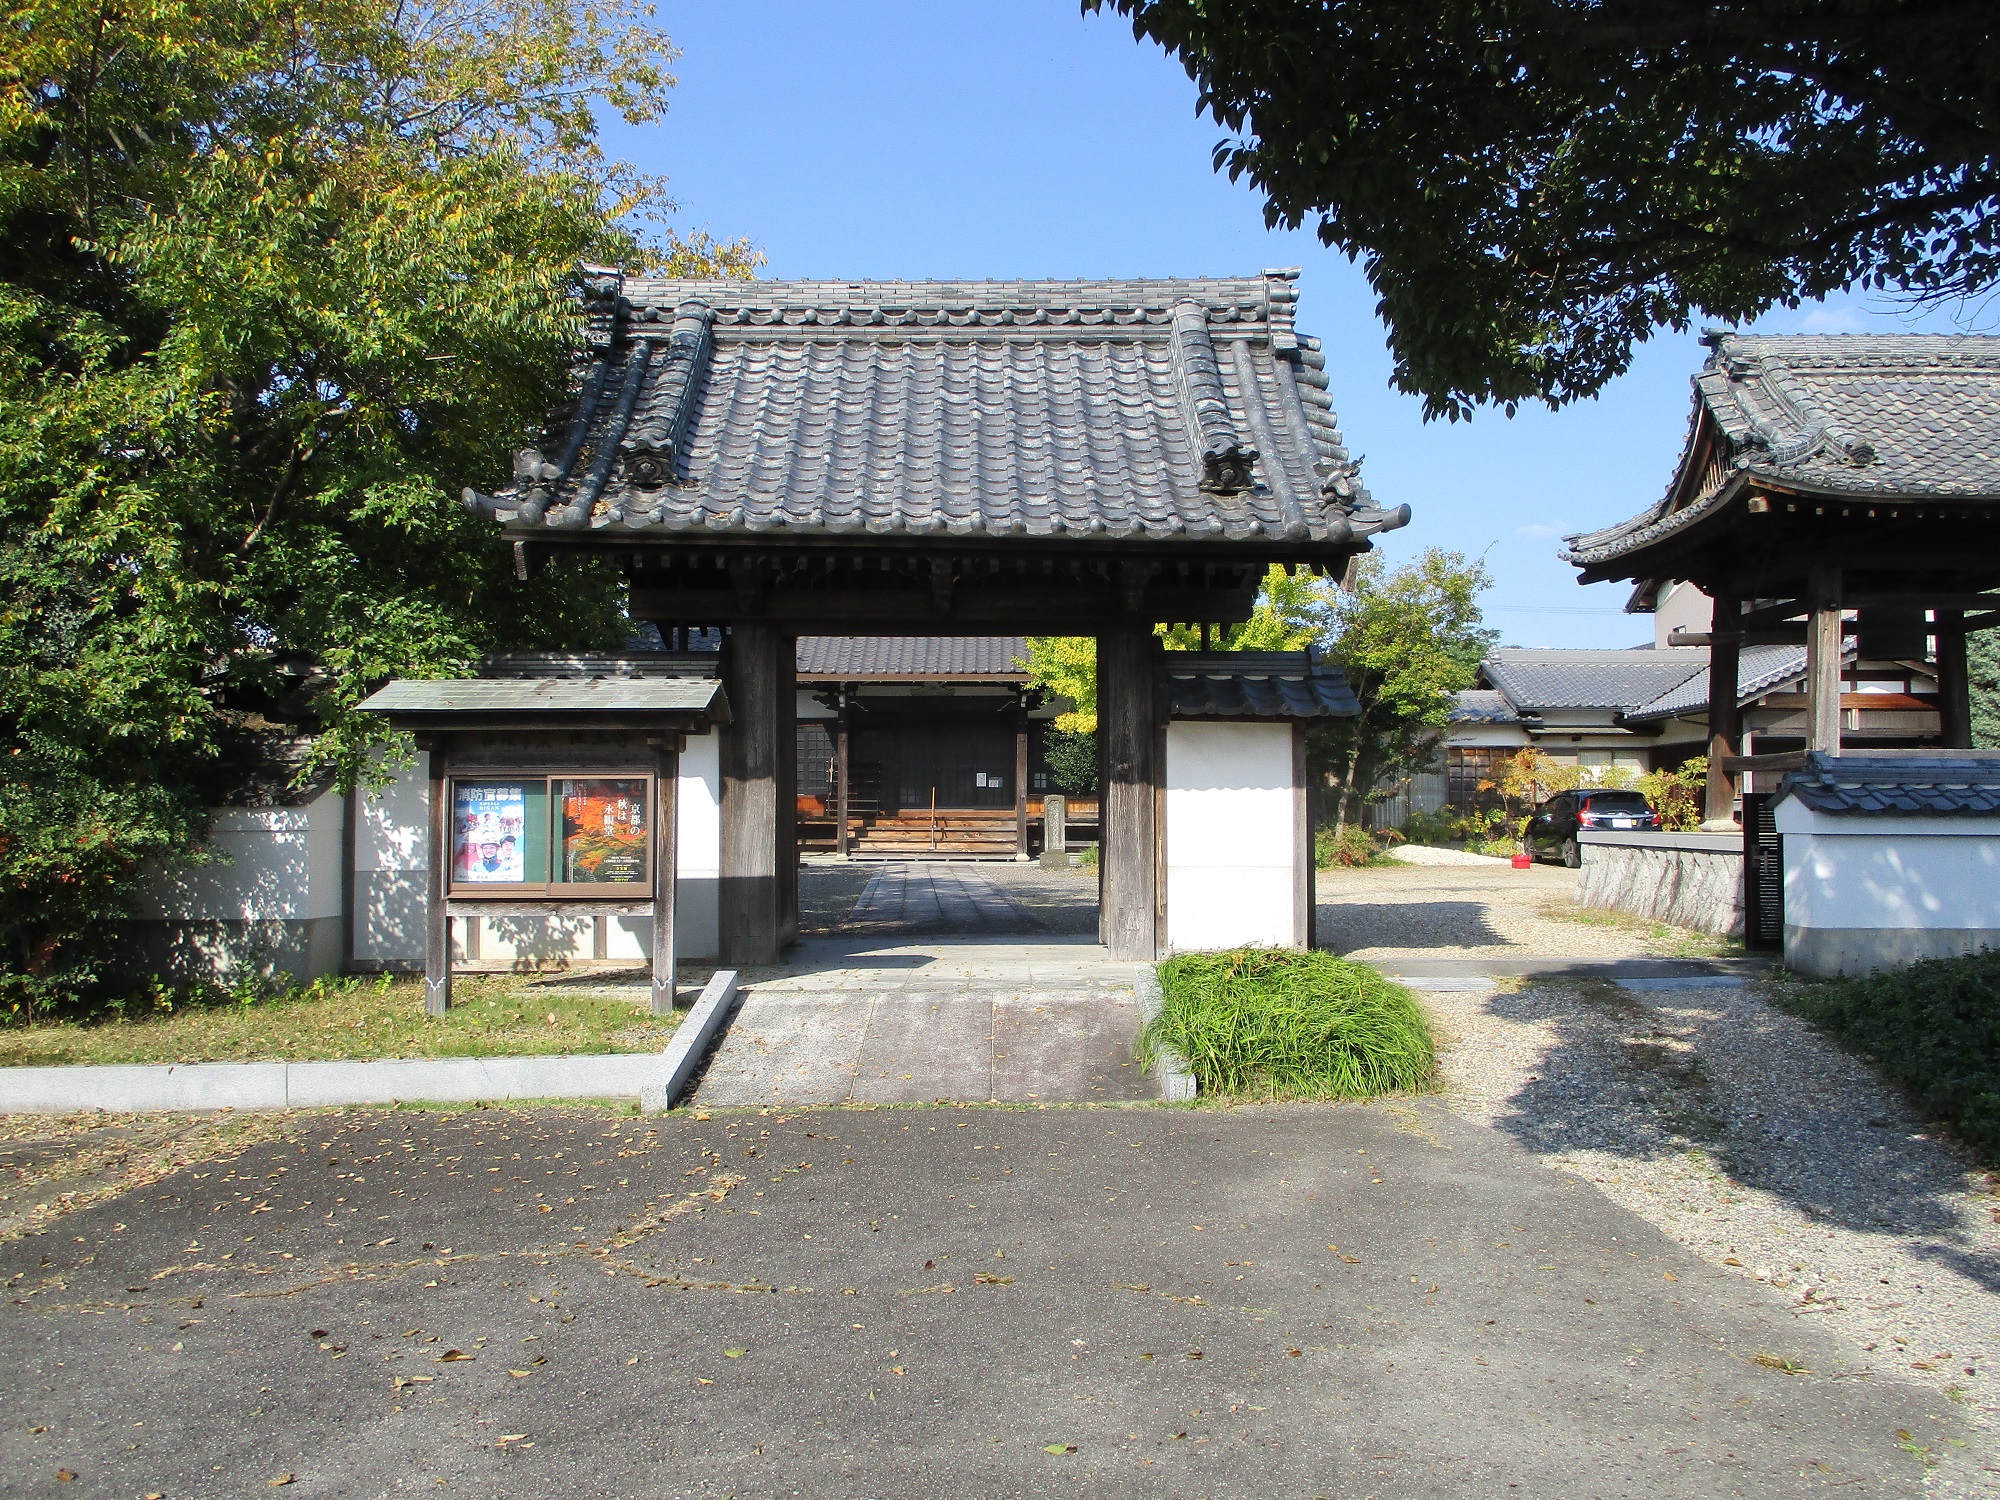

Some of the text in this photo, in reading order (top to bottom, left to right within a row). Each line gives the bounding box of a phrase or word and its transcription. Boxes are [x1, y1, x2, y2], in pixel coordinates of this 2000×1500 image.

[458, 787, 522, 801] 消防官募集
[603, 803, 614, 837] 永観堂
[616, 799, 628, 820] 秋は
[630, 803, 641, 835] 京都の
